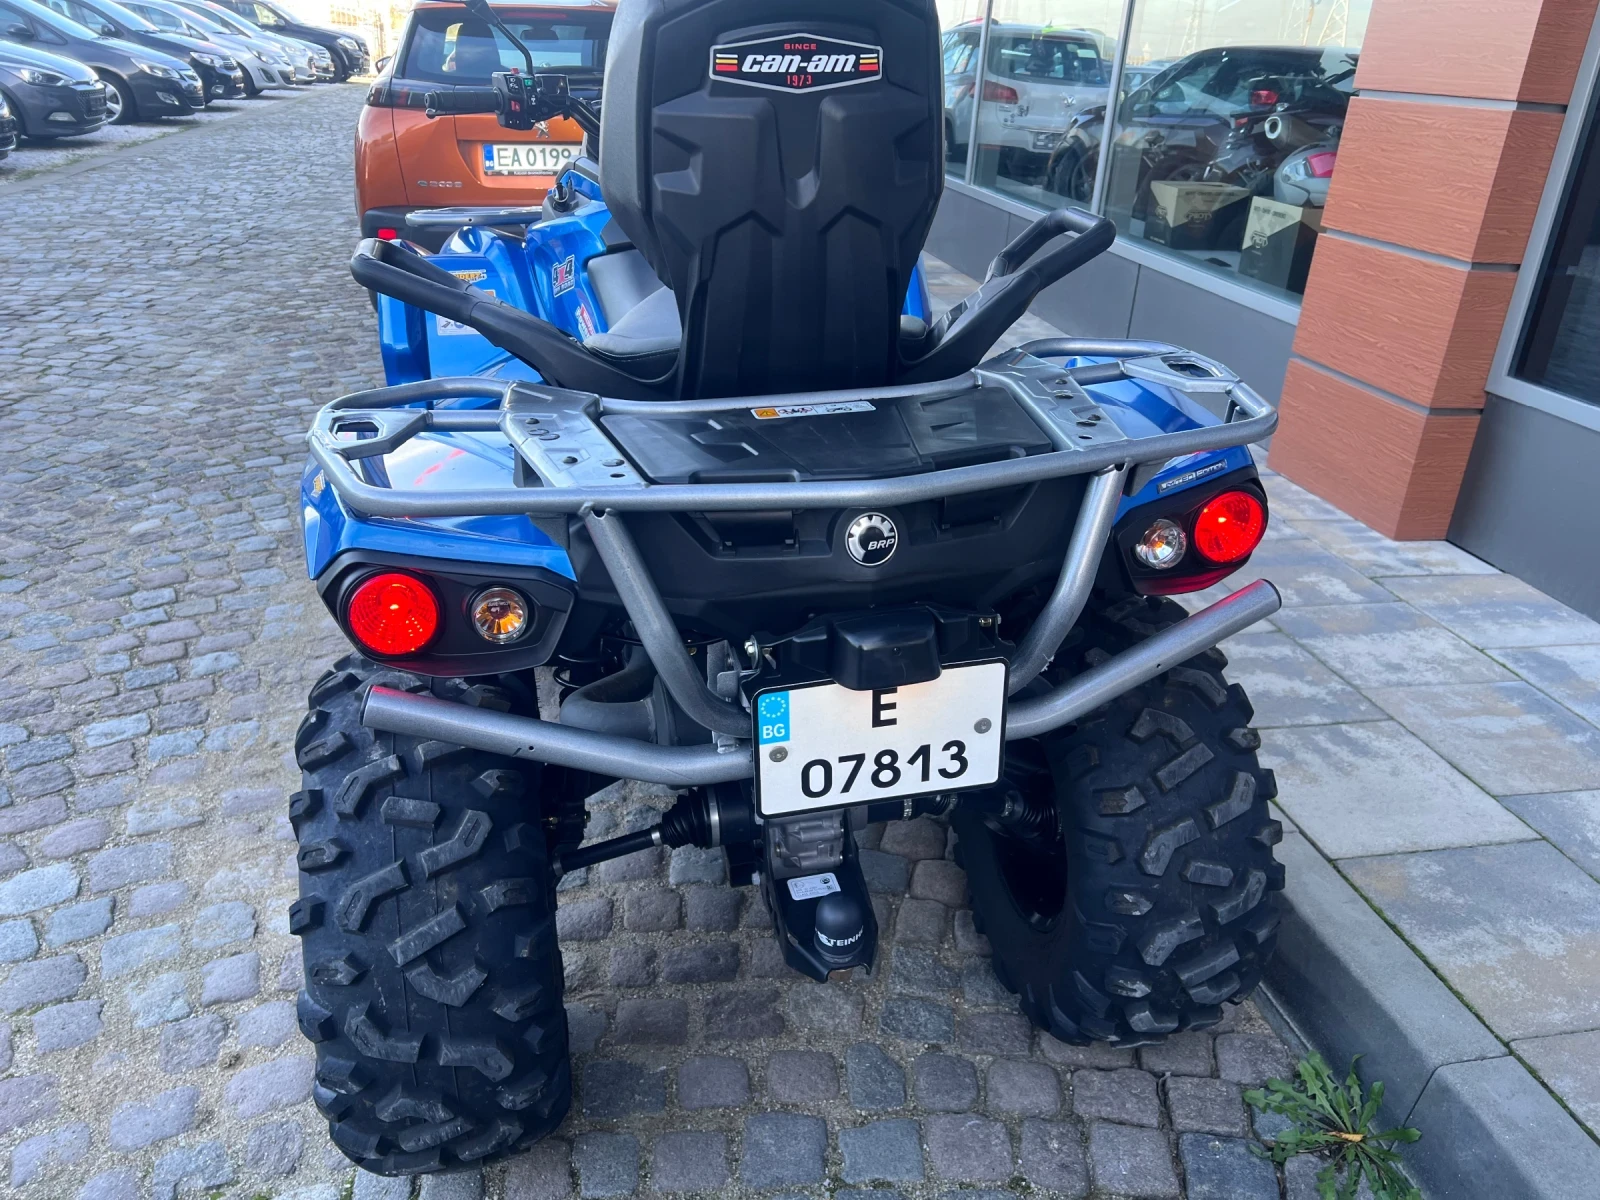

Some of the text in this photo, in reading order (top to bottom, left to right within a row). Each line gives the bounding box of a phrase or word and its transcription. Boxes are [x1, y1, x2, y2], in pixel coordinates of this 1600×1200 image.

[741, 54, 856, 73] can-am
[786, 74, 812, 87] 1973
[497, 147, 522, 167] EA
[867, 538, 895, 551] BRP
[872, 687, 898, 729] E
[762, 724, 785, 739] BG
[801, 740, 969, 798] 07813
